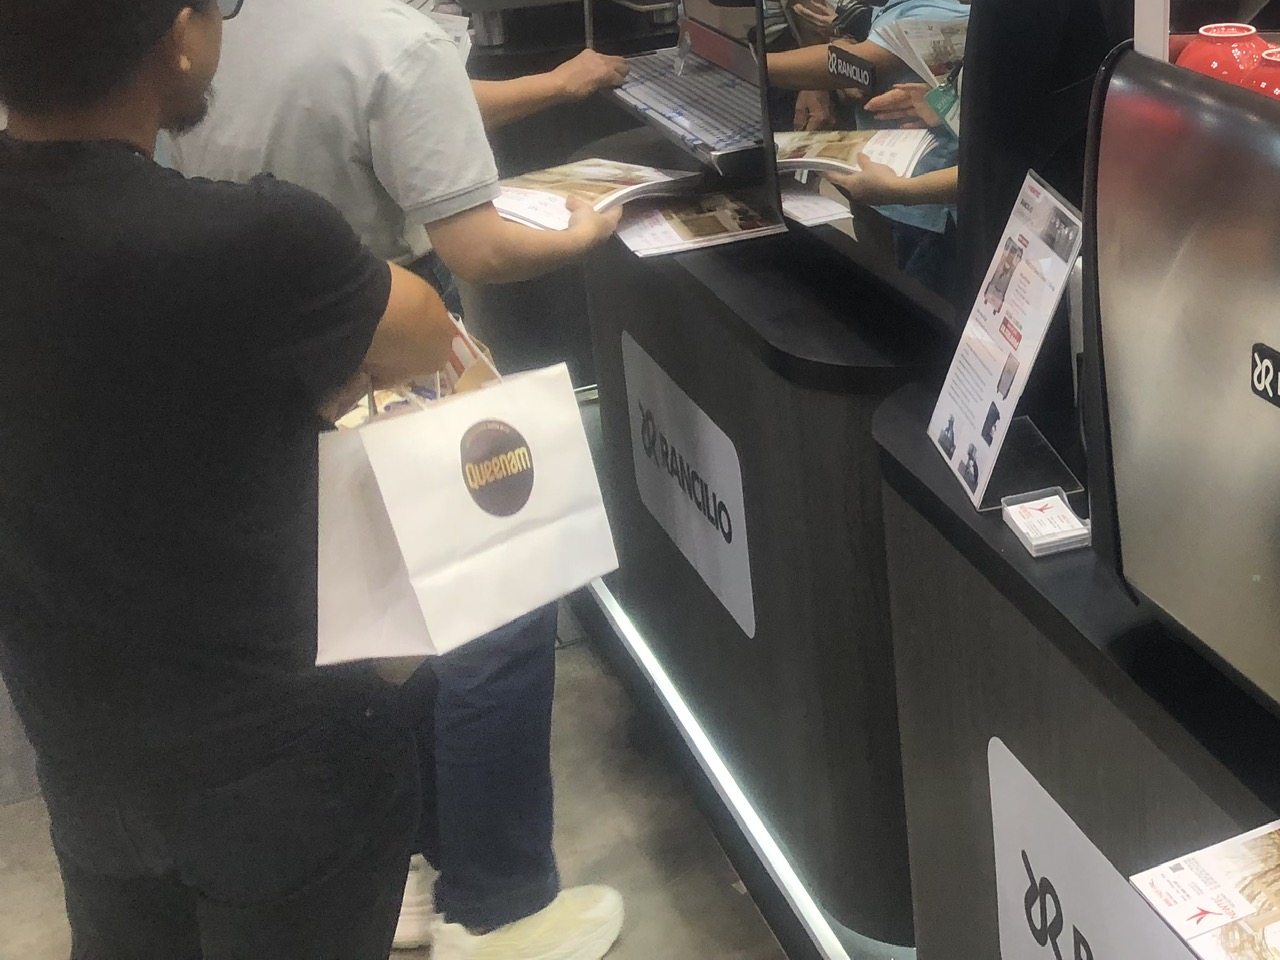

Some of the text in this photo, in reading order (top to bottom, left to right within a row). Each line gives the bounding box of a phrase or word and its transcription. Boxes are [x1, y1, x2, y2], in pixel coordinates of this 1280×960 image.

[838, 58, 870, 86] RANCILIO
[465, 446, 531, 490] Queenam
[659, 432, 733, 545] RANCILIO
